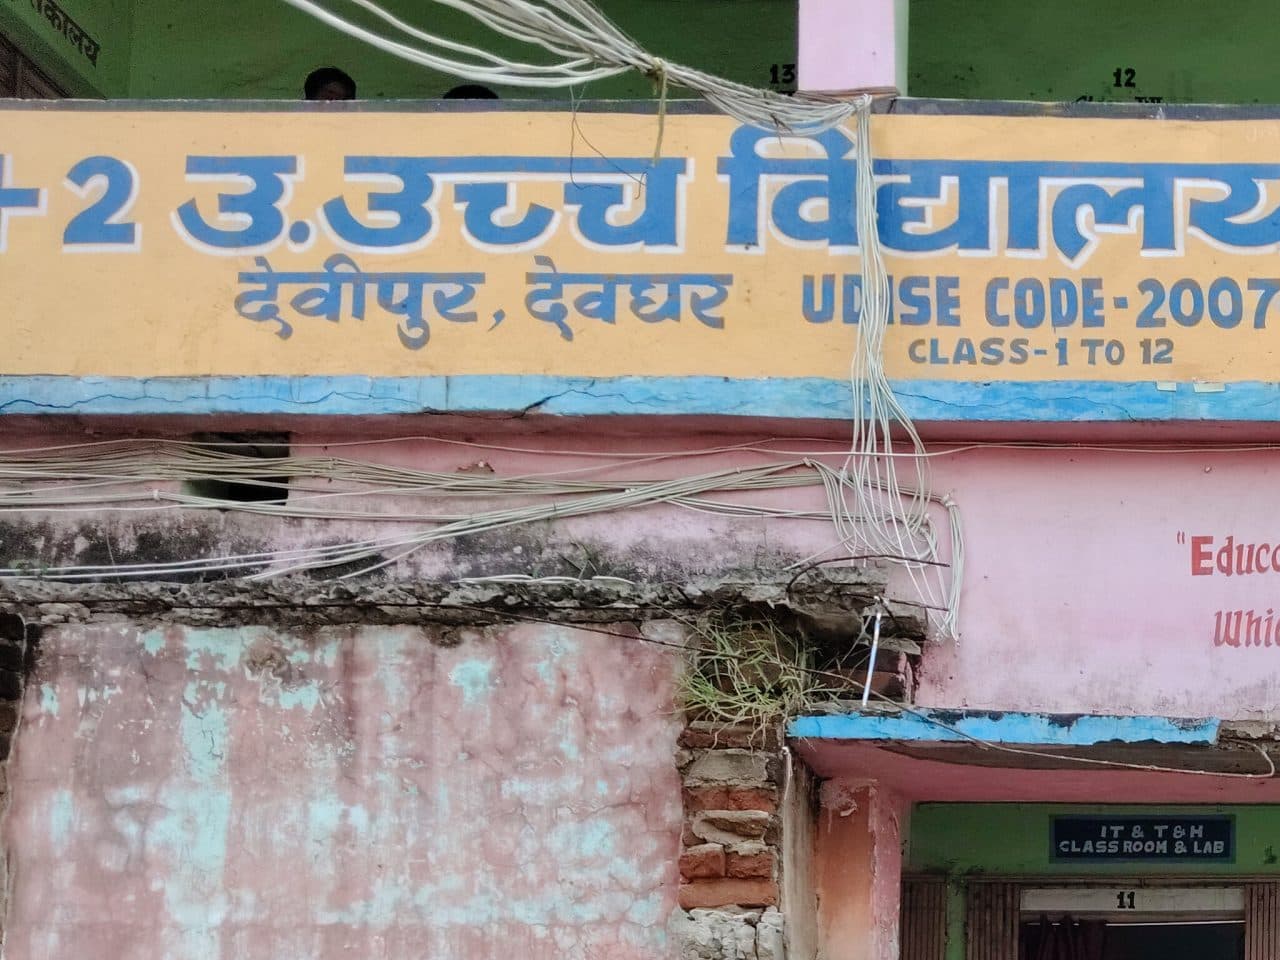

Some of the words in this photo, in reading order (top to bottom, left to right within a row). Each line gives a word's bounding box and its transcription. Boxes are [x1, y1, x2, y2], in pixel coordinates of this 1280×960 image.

[769, 63, 796, 84] 13
[1112, 67, 1136, 88] 12
[526, 255, 734, 340] देवघर
[803, 274, 961, 326] UDISE
[1079, 339, 1126, 366] TO
[1141, 338, 1174, 365] 12
[1100, 825, 1125, 838] IT
[1174, 840, 1188, 854] &
[1193, 840, 1226, 854] LAB
[1116, 891, 1136, 910] 11
